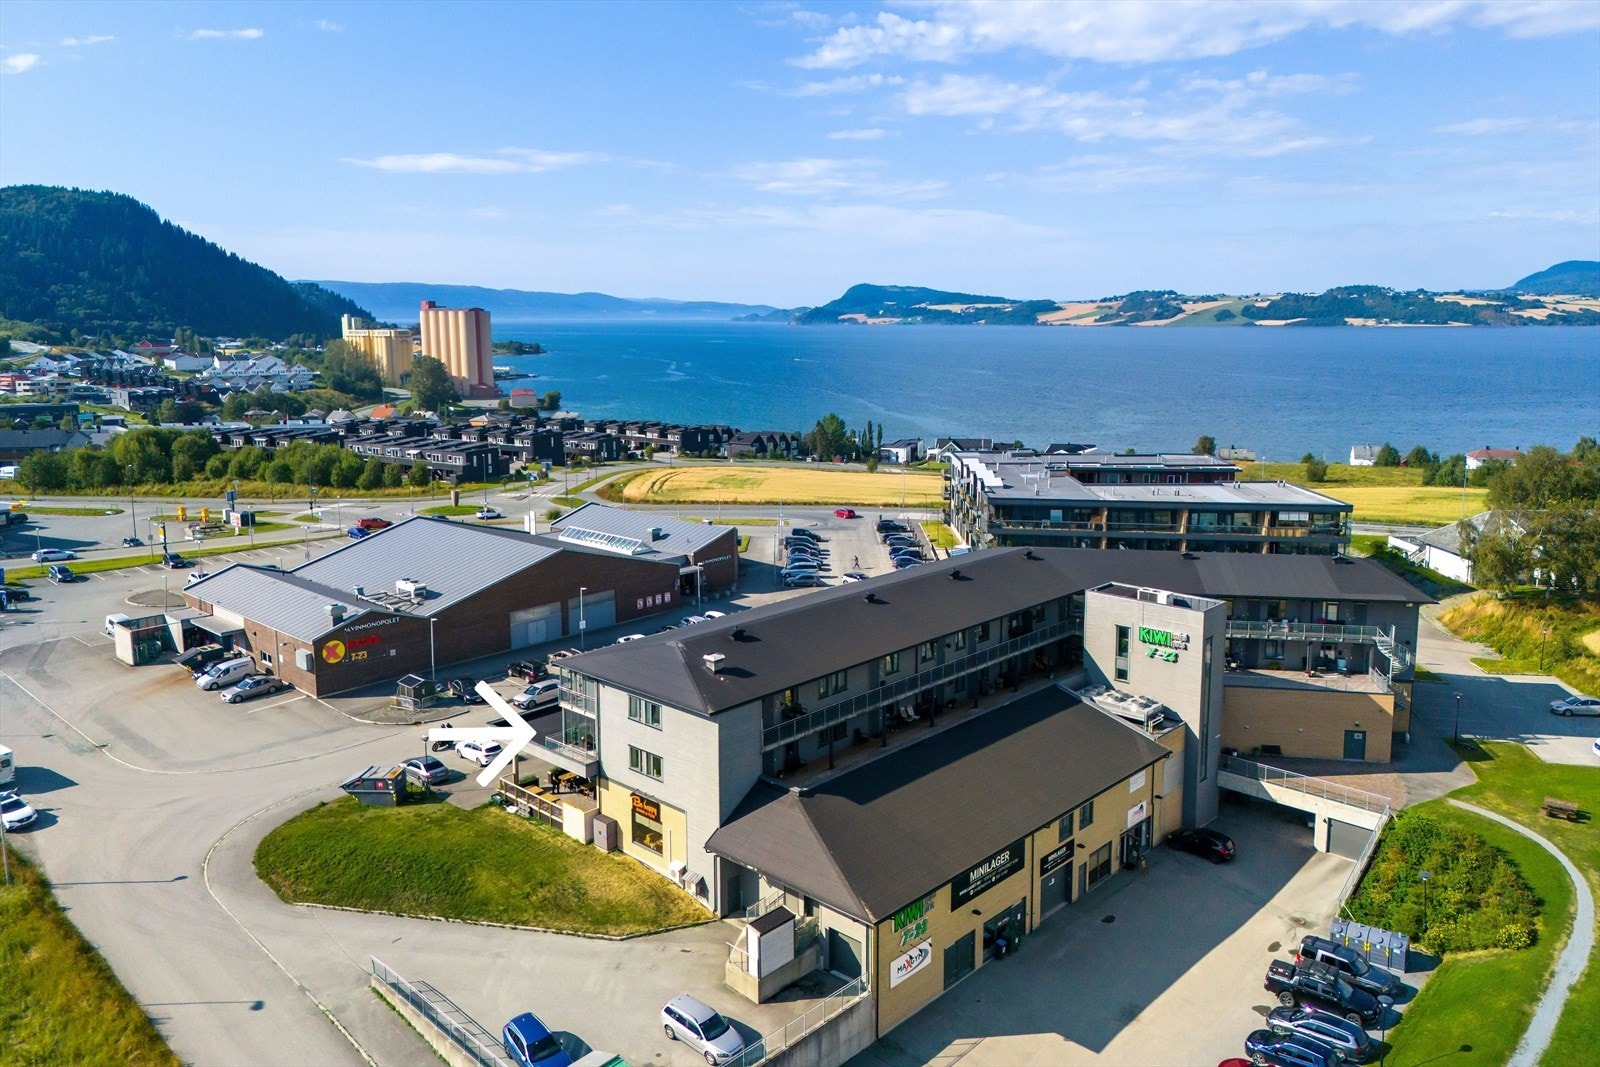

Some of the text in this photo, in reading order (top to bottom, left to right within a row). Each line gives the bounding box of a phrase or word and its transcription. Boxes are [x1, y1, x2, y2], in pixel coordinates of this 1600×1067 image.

[351, 616, 400, 632] VINMONOPOLET
[1139, 626, 1171, 648] KIWI
[1147, 647, 1178, 663] 7-23
[970, 851, 1010, 882] MINILAGER
[892, 899, 924, 933] KIWI
[901, 917, 928, 946] 7-23
